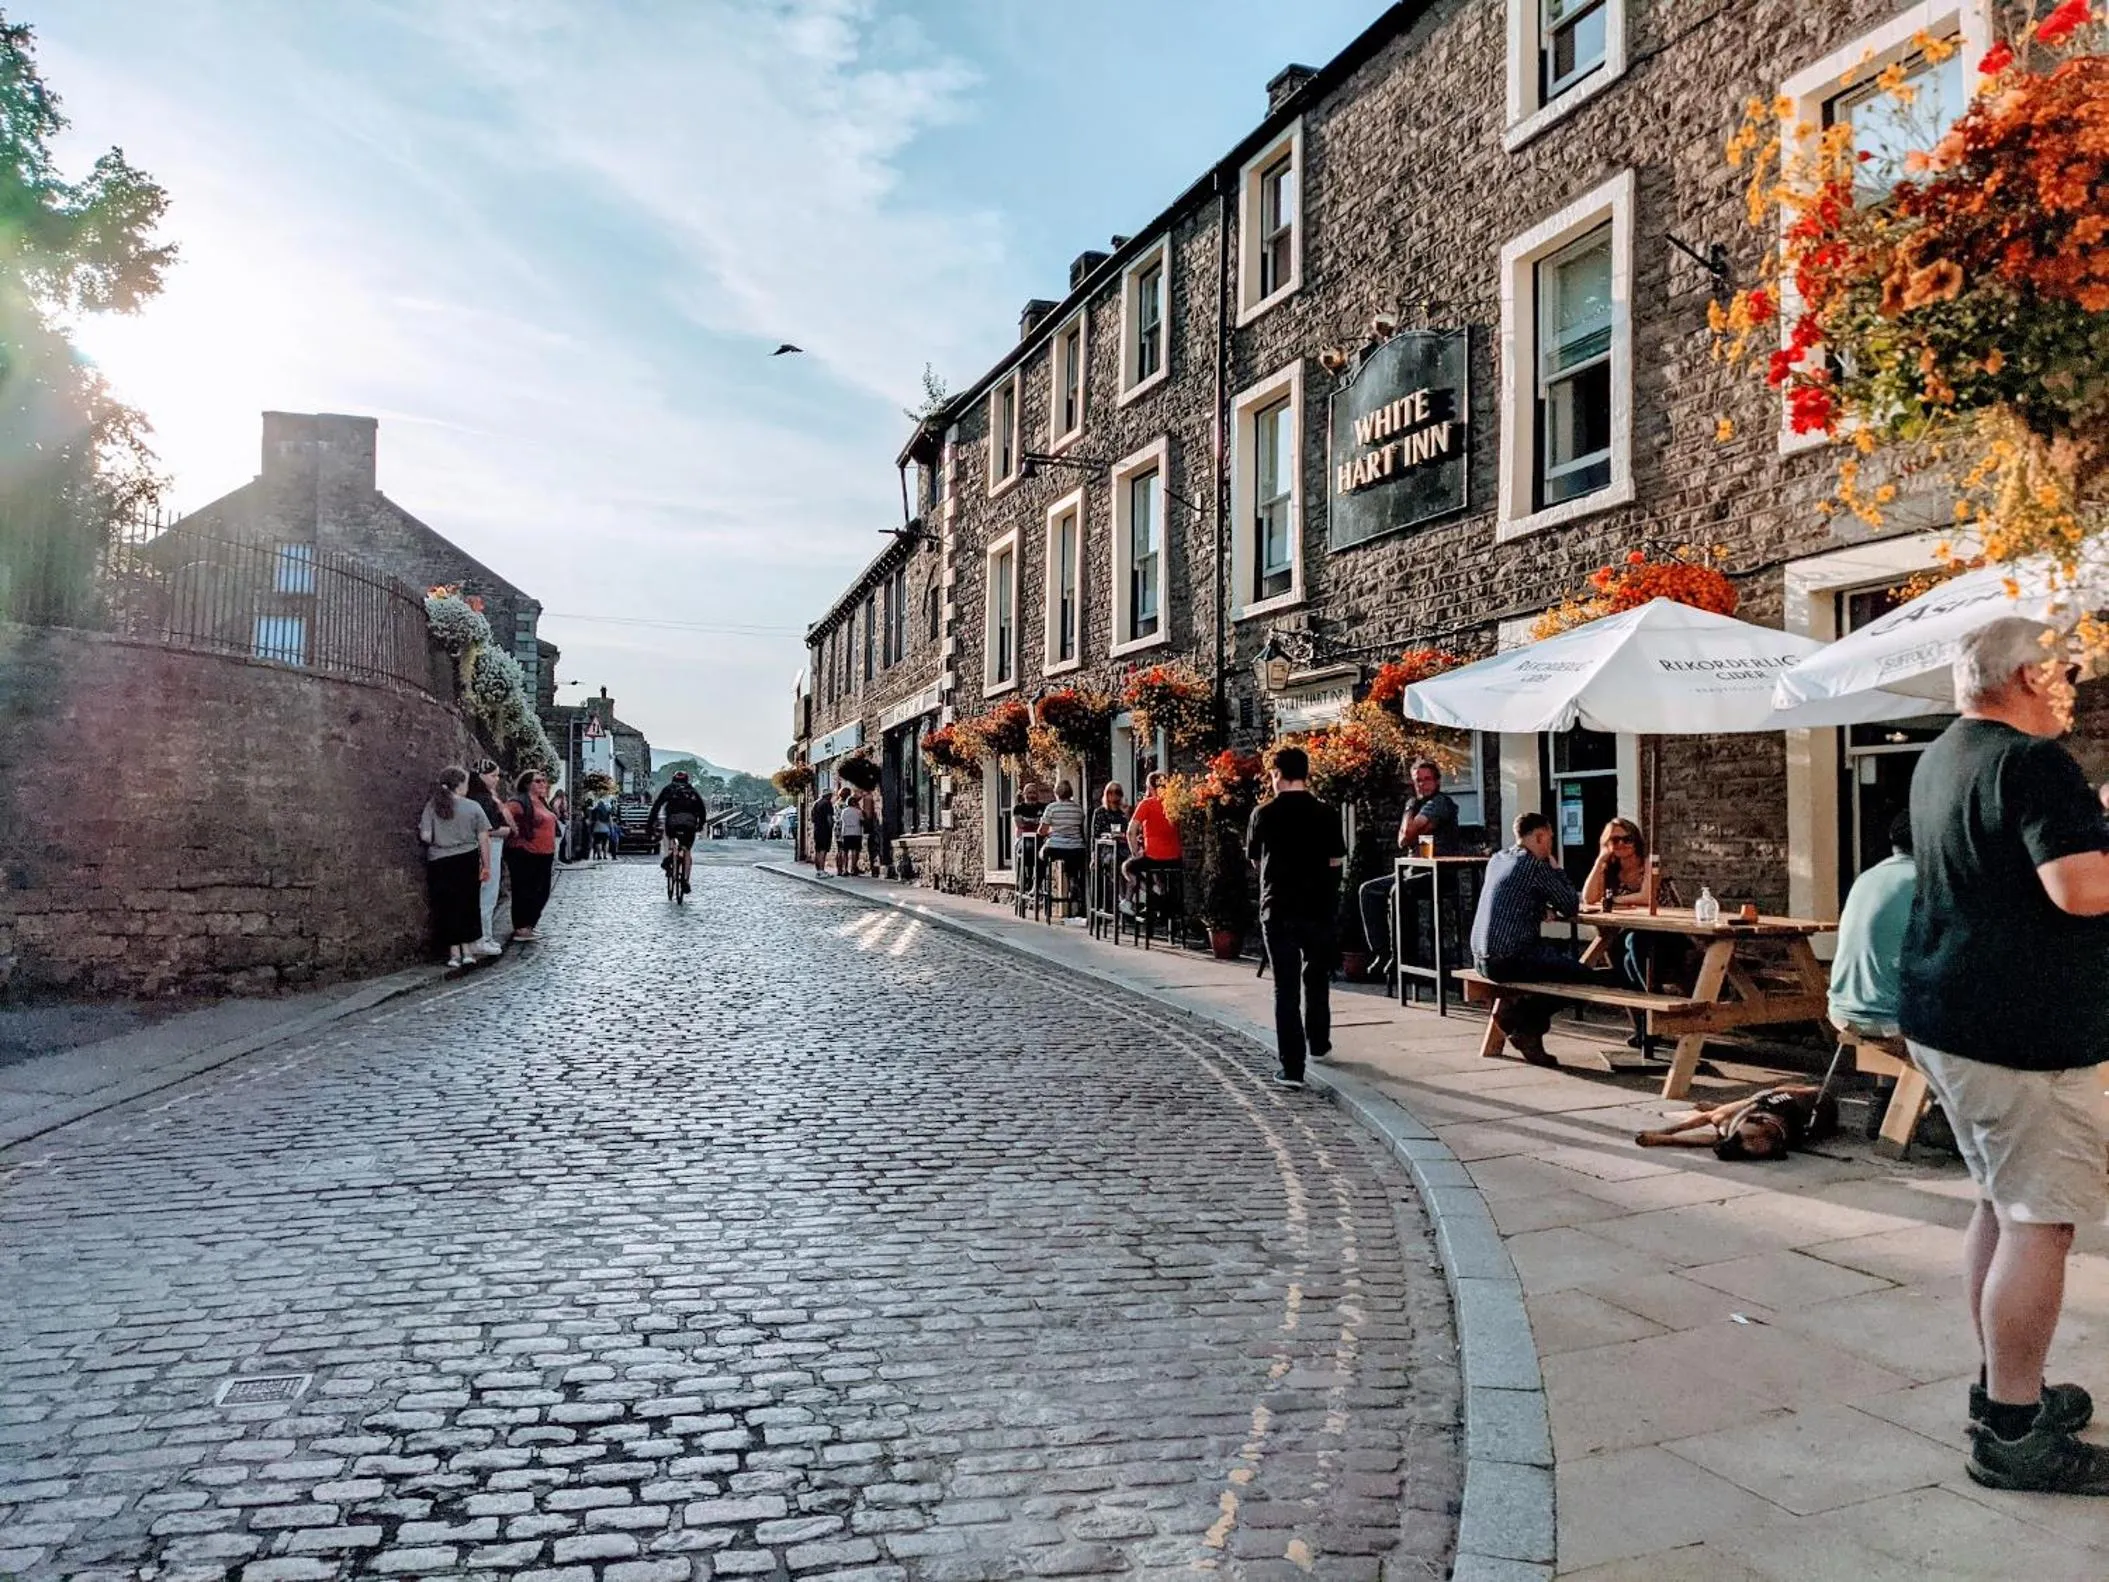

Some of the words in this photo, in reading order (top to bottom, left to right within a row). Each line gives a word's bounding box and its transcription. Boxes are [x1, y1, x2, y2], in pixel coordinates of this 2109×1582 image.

[1354, 388, 1430, 446] WHITE
[1336, 442, 1398, 496] HART
[1404, 421, 1451, 467] INN
[1716, 669, 1769, 681] CIDER
